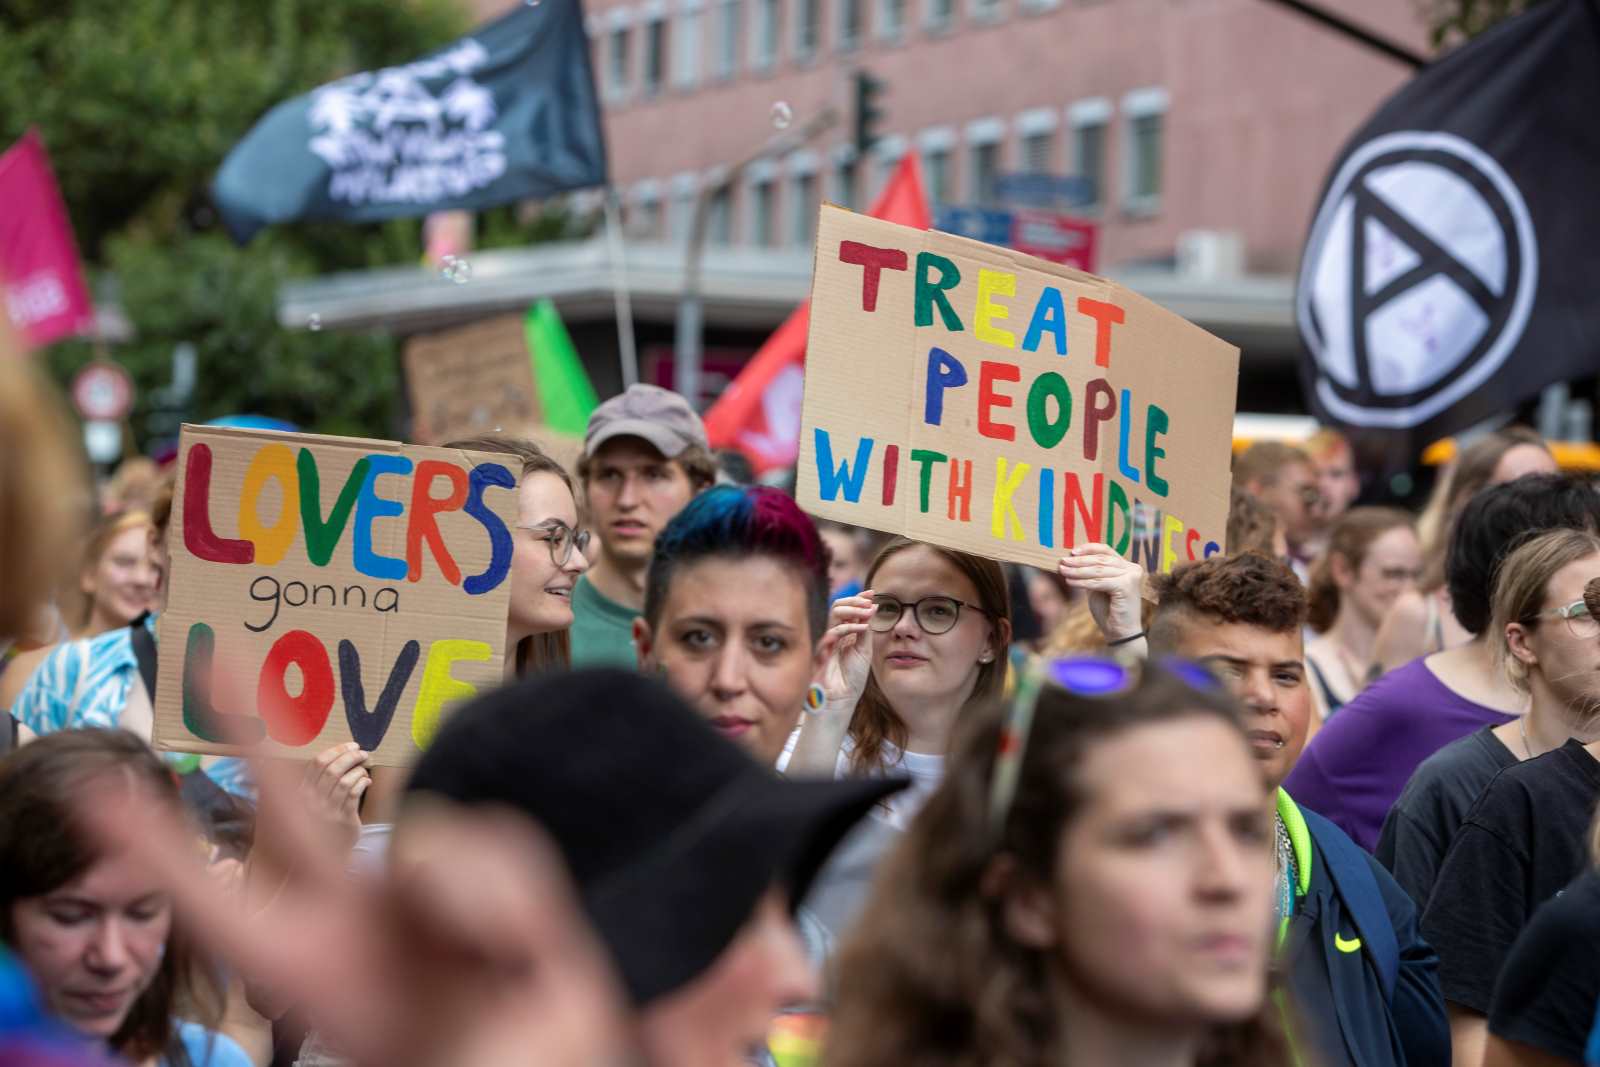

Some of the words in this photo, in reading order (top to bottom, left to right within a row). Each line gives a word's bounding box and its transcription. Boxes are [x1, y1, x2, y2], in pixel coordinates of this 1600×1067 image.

[838, 239, 1126, 369] TREAT
[814, 427, 973, 522] WITH
[923, 346, 1170, 498] PEOPLE
[182, 442, 516, 596] LOVERS
[243, 575, 400, 633] gonna
[182, 622, 493, 752] LOVE
